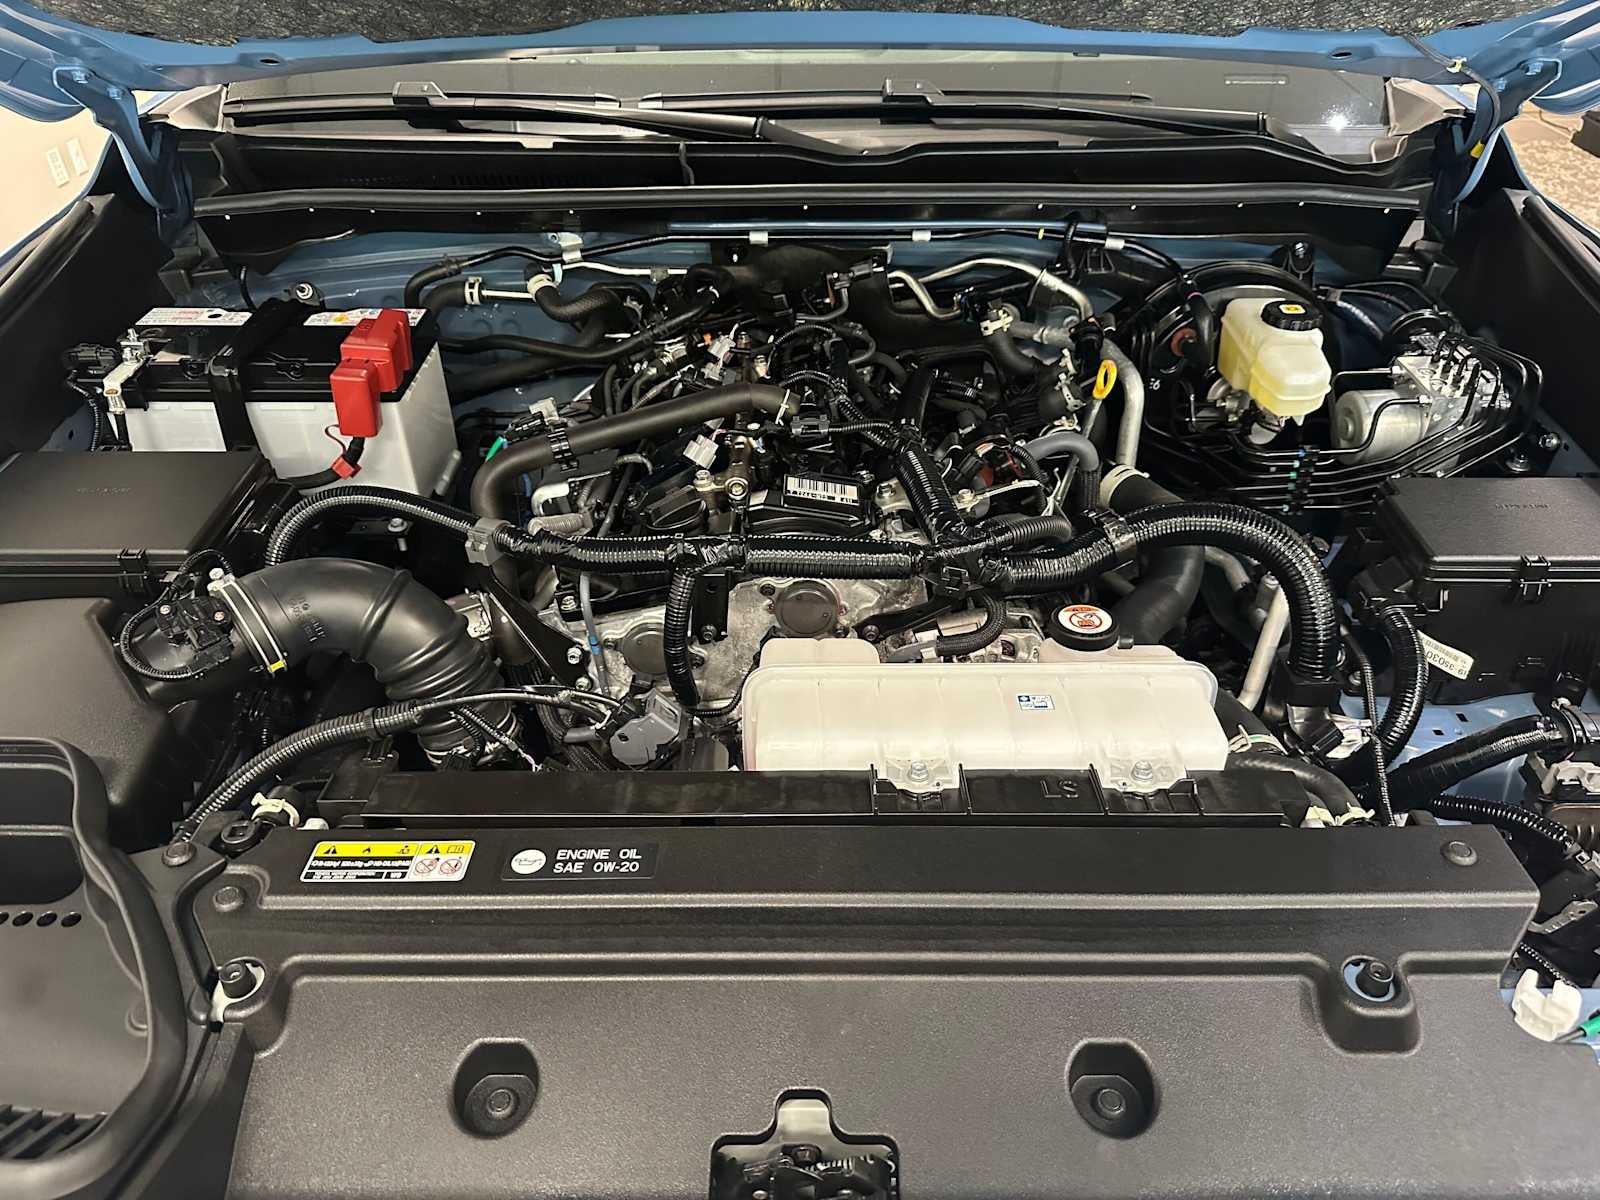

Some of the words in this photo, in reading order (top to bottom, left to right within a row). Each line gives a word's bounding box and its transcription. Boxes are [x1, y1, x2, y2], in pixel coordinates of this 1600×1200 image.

[1040, 780, 1079, 798] LS
[556, 848, 611, 860] ENGINE
[619, 848, 642, 859] OIL
[553, 861, 585, 873] SAE
[593, 861, 640, 873] 0W-20
